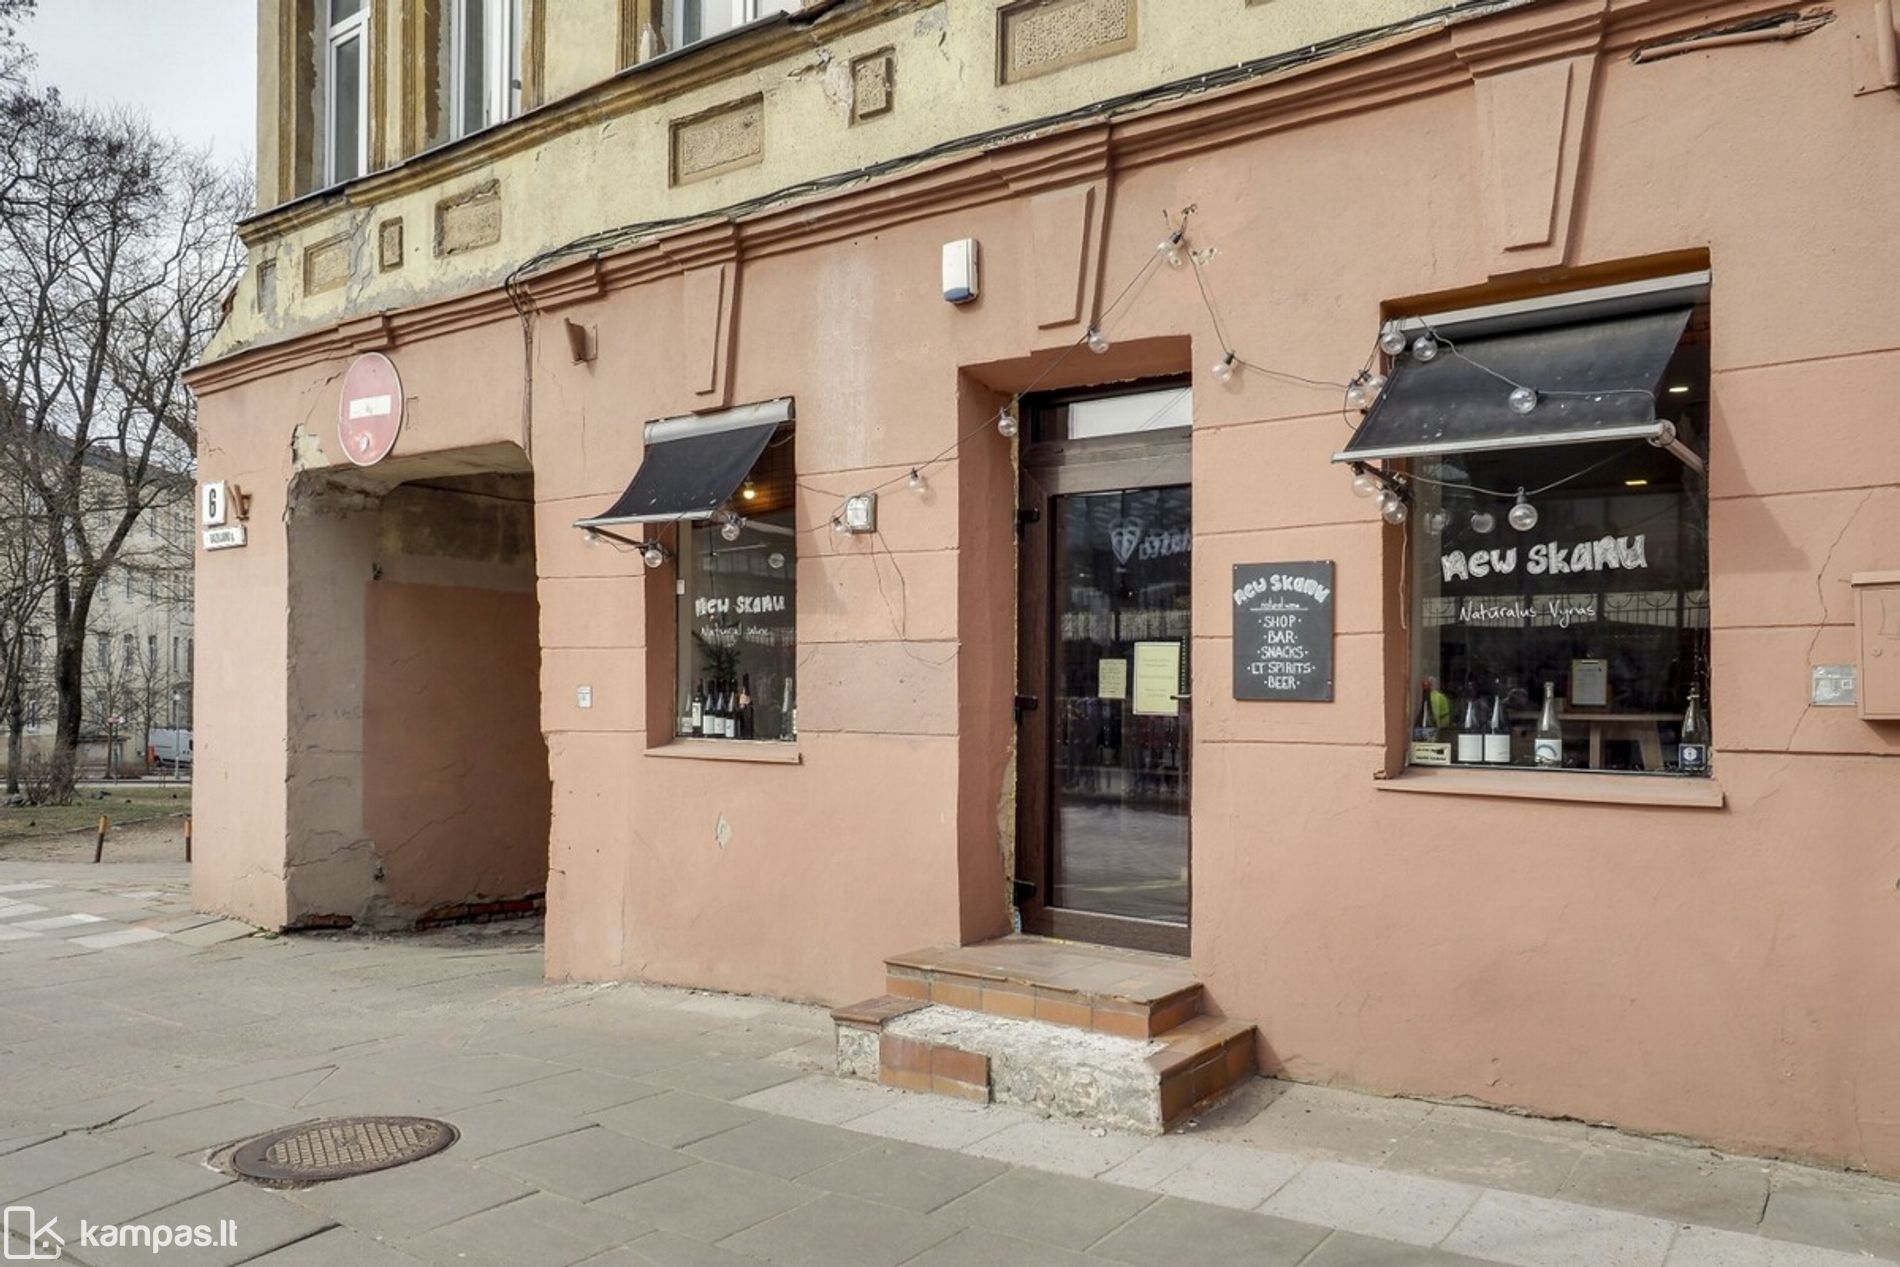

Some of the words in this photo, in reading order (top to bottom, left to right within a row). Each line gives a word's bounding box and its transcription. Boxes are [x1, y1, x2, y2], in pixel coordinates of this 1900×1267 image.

[208, 487, 217, 519] 6
[1263, 614, 1296, 628] SHOP
[1548, 599, 1596, 628] Vynas
[1268, 630, 1295, 644] BAR
[1260, 645, 1304, 660] SNACKS
[1268, 661, 1312, 674] SPIRITS
[1267, 675, 1296, 690] BEER
